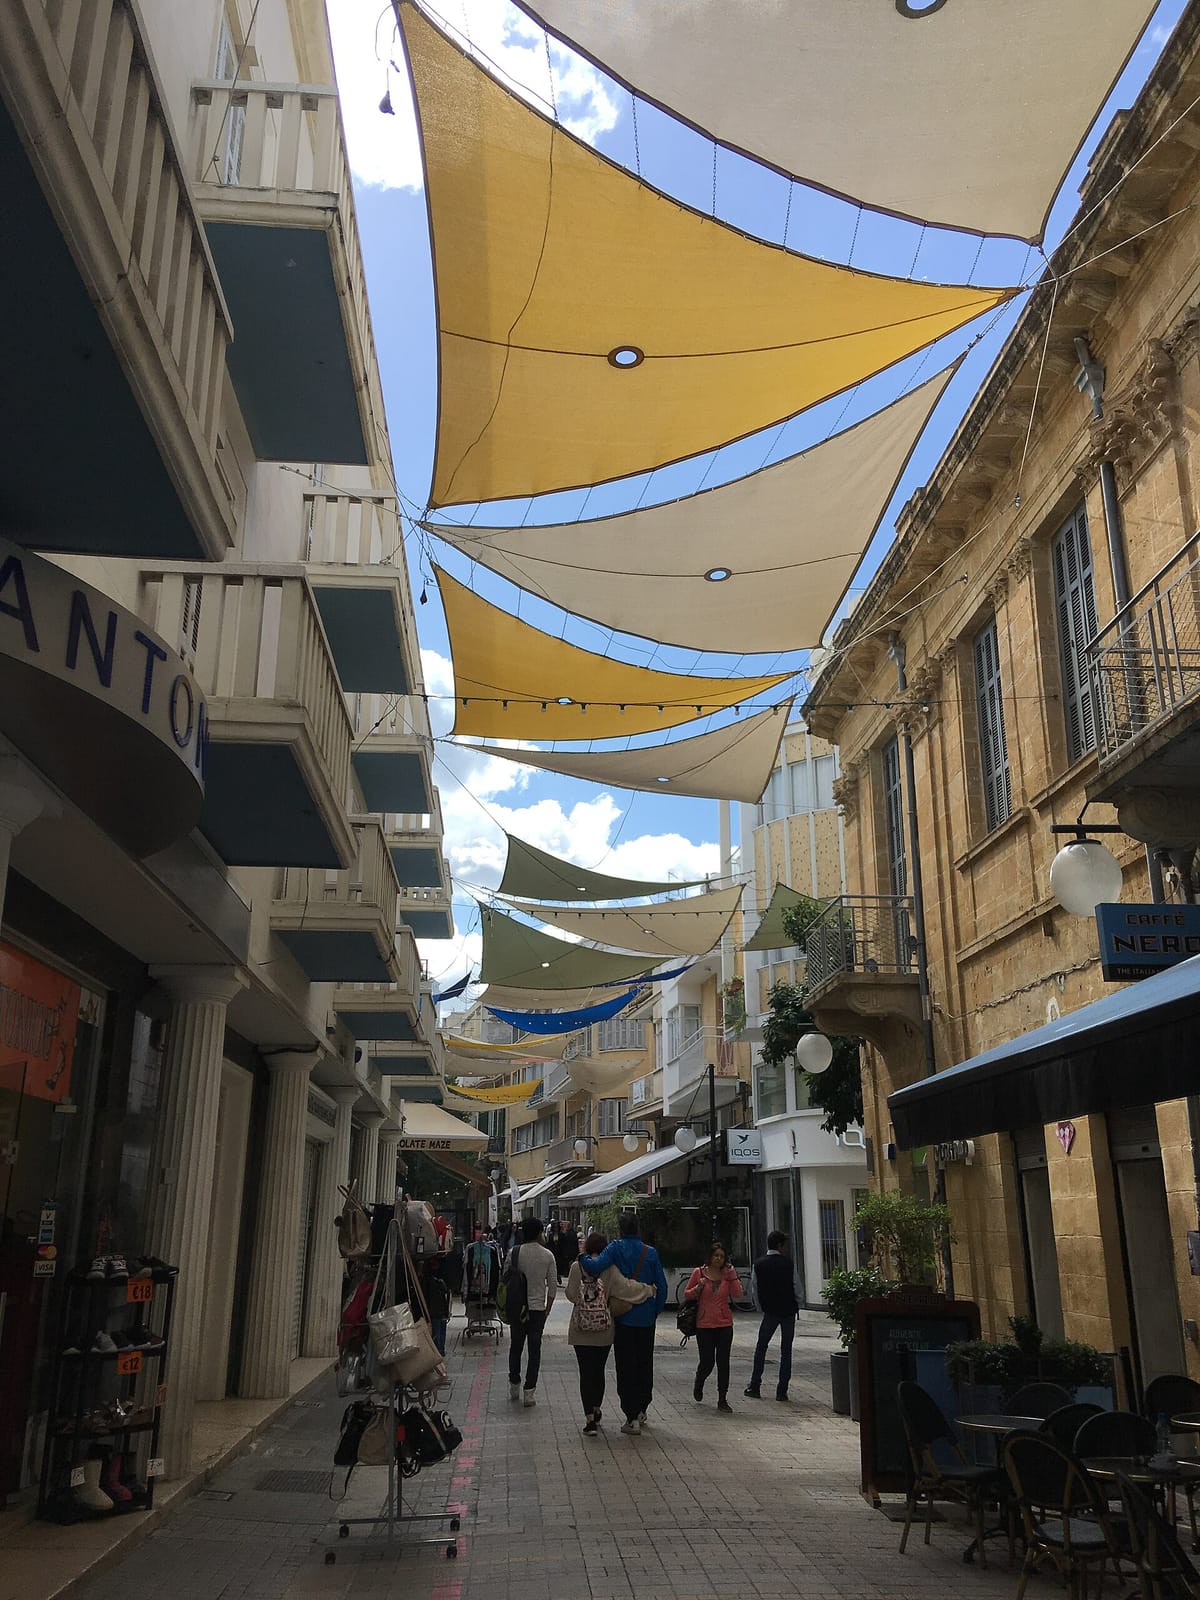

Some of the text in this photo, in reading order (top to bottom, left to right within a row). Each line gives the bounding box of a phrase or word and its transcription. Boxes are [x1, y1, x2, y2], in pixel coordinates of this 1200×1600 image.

[1117, 967, 1131, 975] THE
[429, 1140, 451, 1149] MAZE
[731, 1148, 761, 1157] IQOS
[39, 1263, 54, 1272] VISA
[132, 1285, 151, 1300] €18
[122, 1357, 140, 1371] €12
